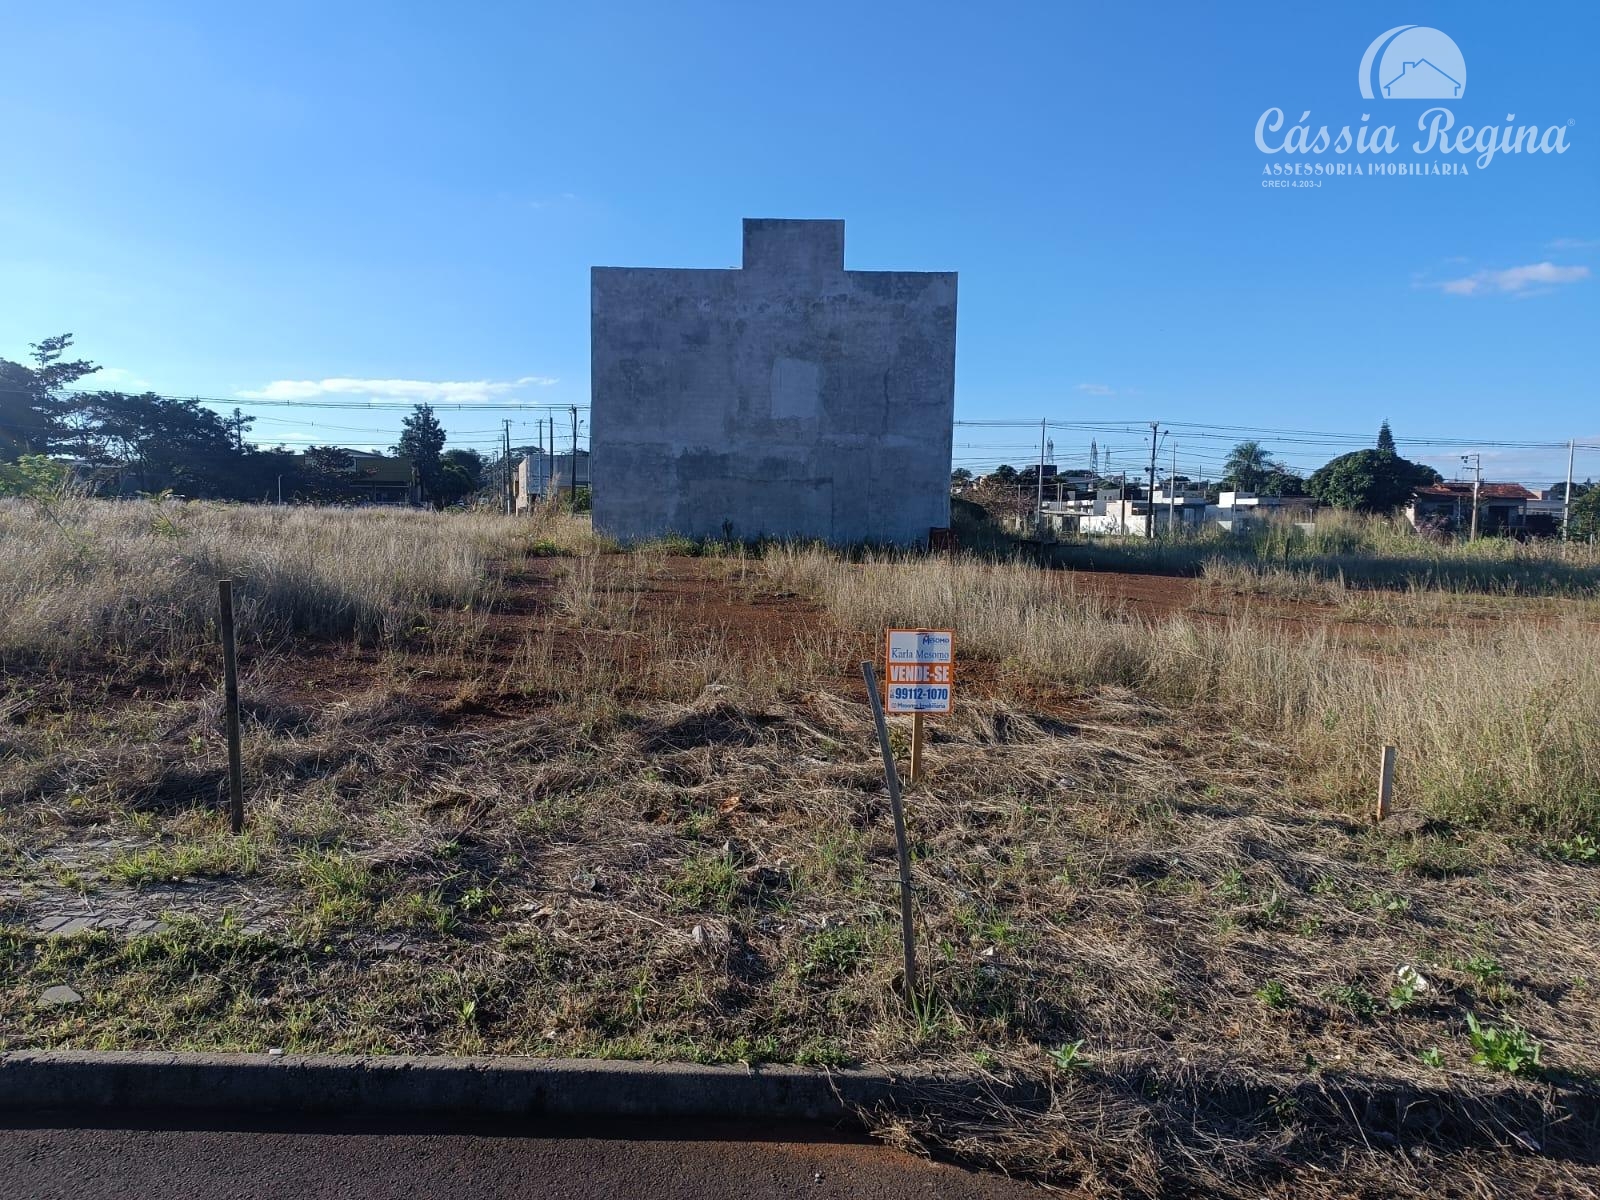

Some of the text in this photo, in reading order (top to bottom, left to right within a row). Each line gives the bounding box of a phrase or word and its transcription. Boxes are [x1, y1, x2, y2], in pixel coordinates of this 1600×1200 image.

[891, 649, 950, 659] Karla Mesomo
[890, 665, 950, 682] VENDE-SE
[895, 687, 948, 700] 99112-1070
